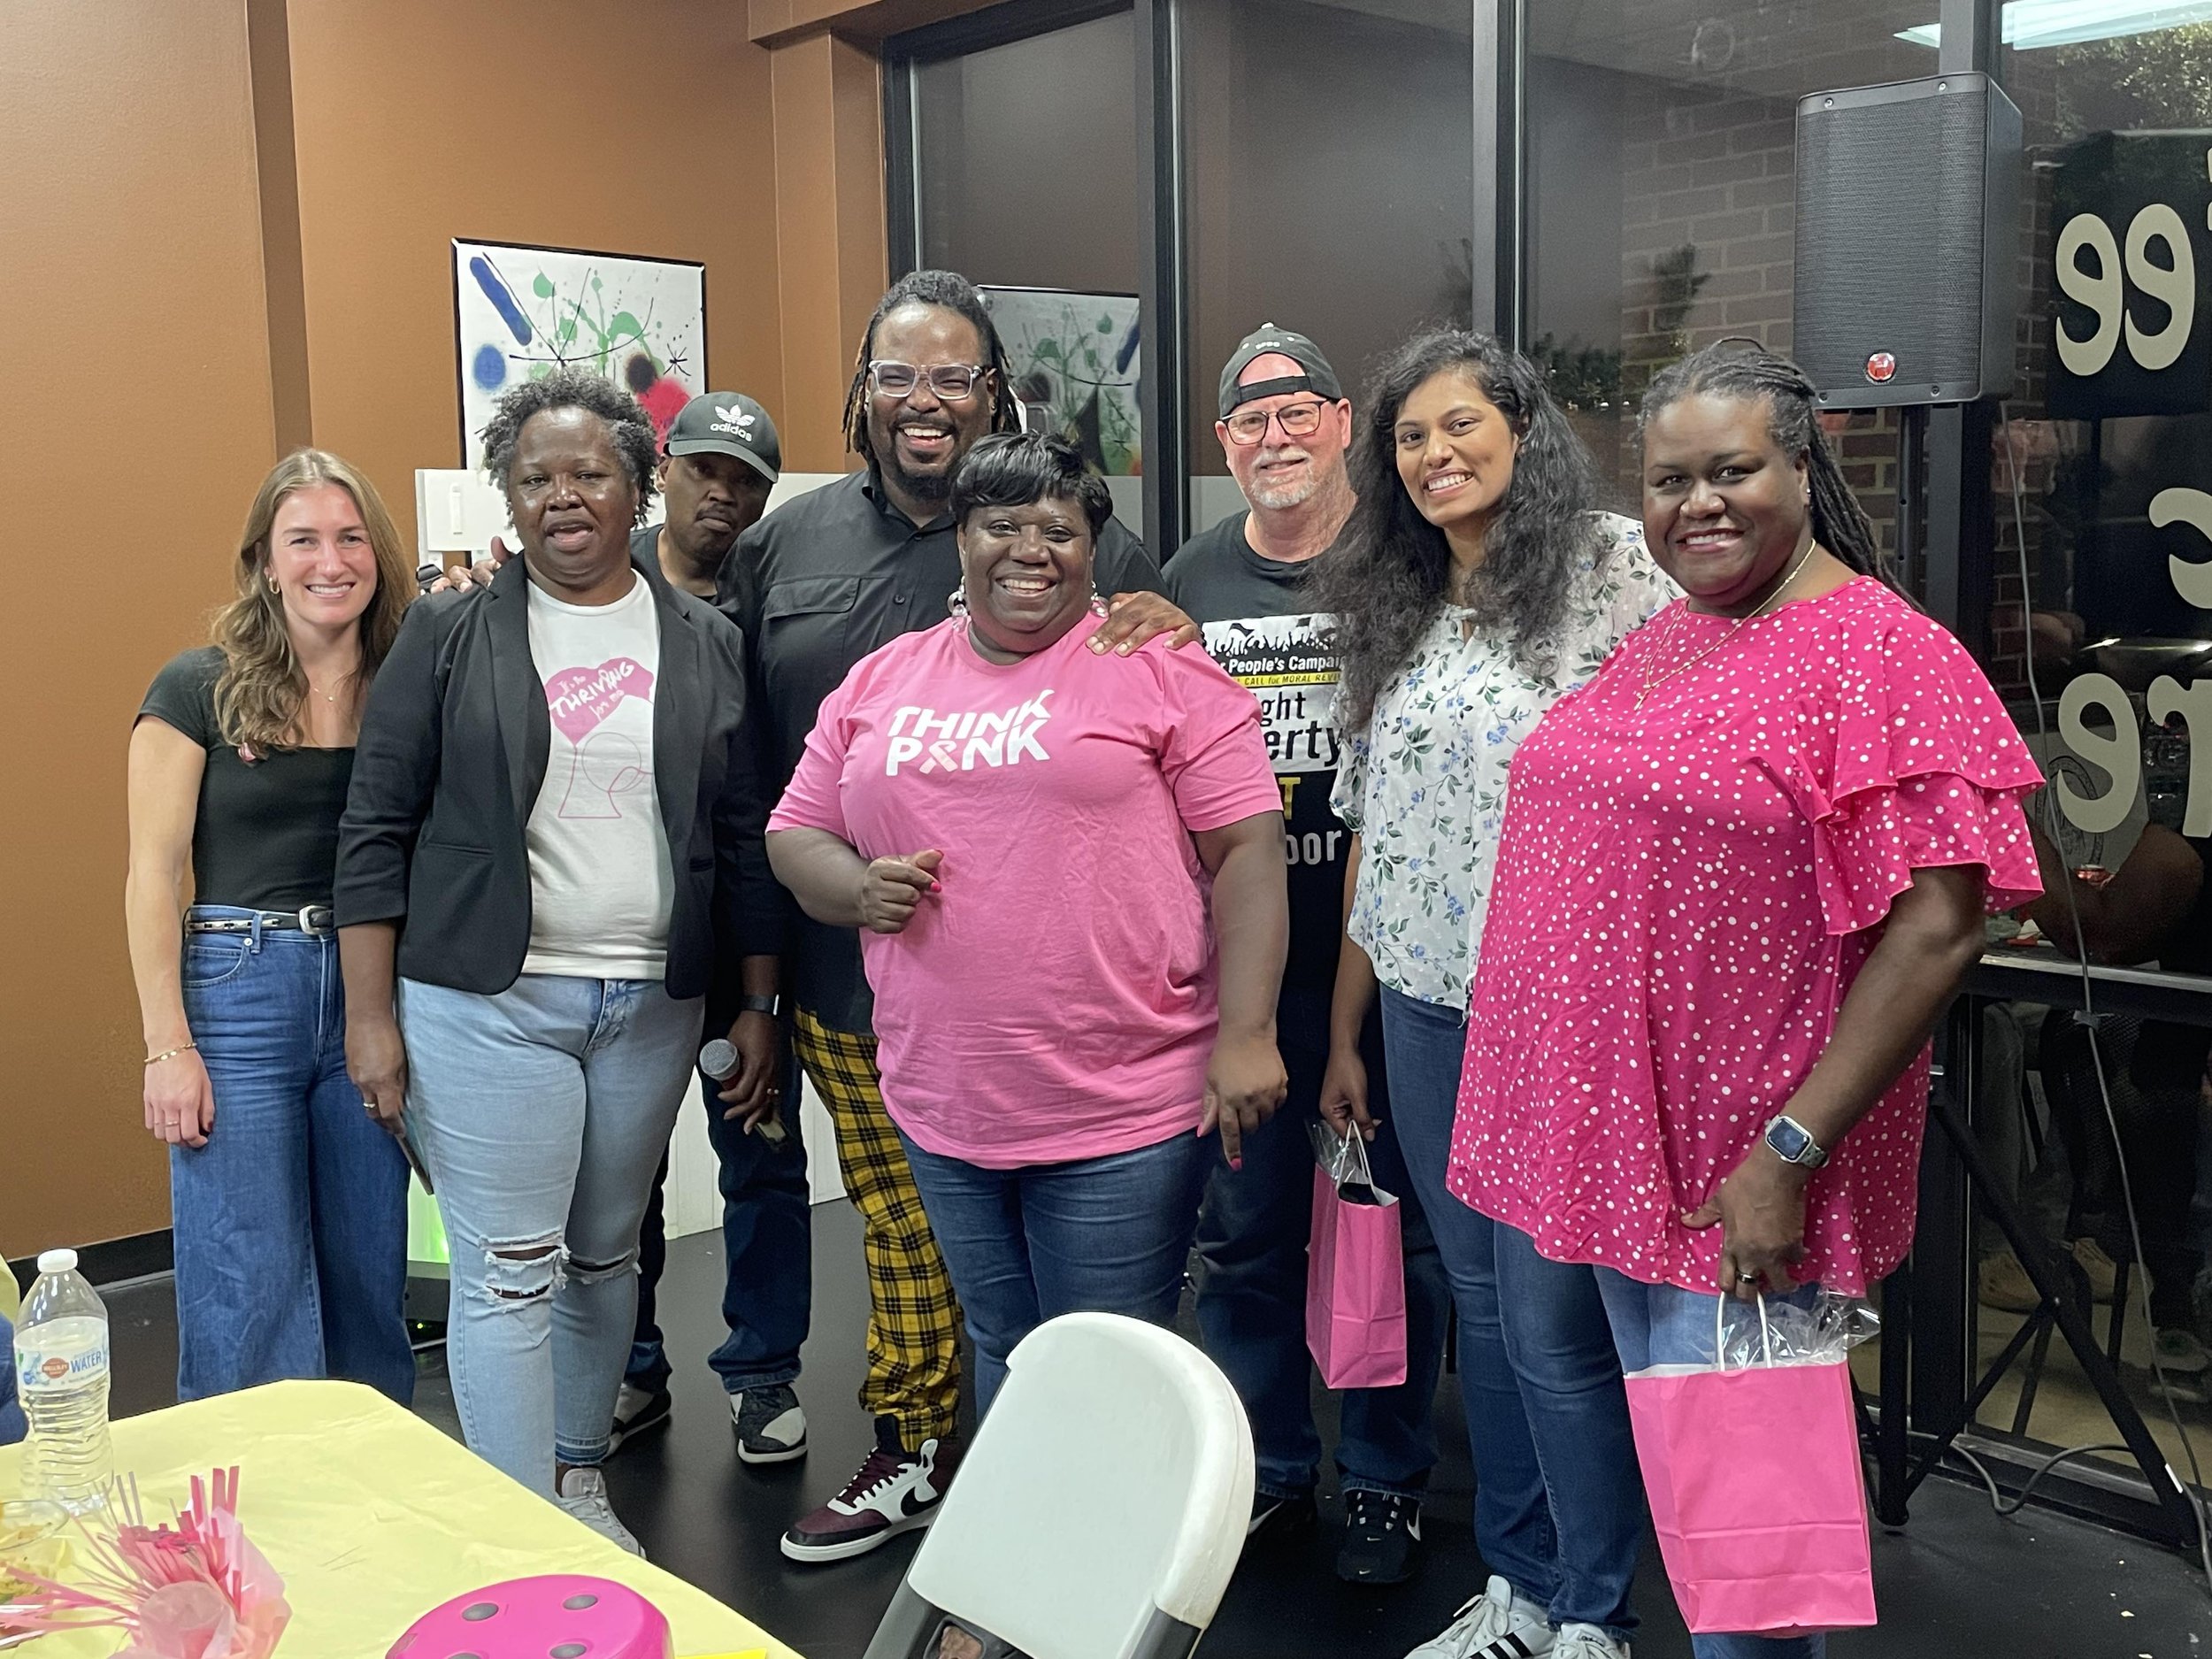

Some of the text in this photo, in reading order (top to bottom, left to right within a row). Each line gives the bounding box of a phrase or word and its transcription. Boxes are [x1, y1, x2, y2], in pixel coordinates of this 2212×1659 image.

[710, 423, 752, 442] adidas
[1228, 657, 1285, 675] People's
[1244, 676, 1264, 686] CALL
[1282, 673, 1310, 684] MORAL
[887, 688, 1055, 739] THINK
[1260, 691, 1306, 726] ght
[1263, 720, 1342, 767] erty
[1279, 776, 1301, 820] T
[1286, 829, 1341, 865] oor
[70, 1351, 102, 1372] WATER
